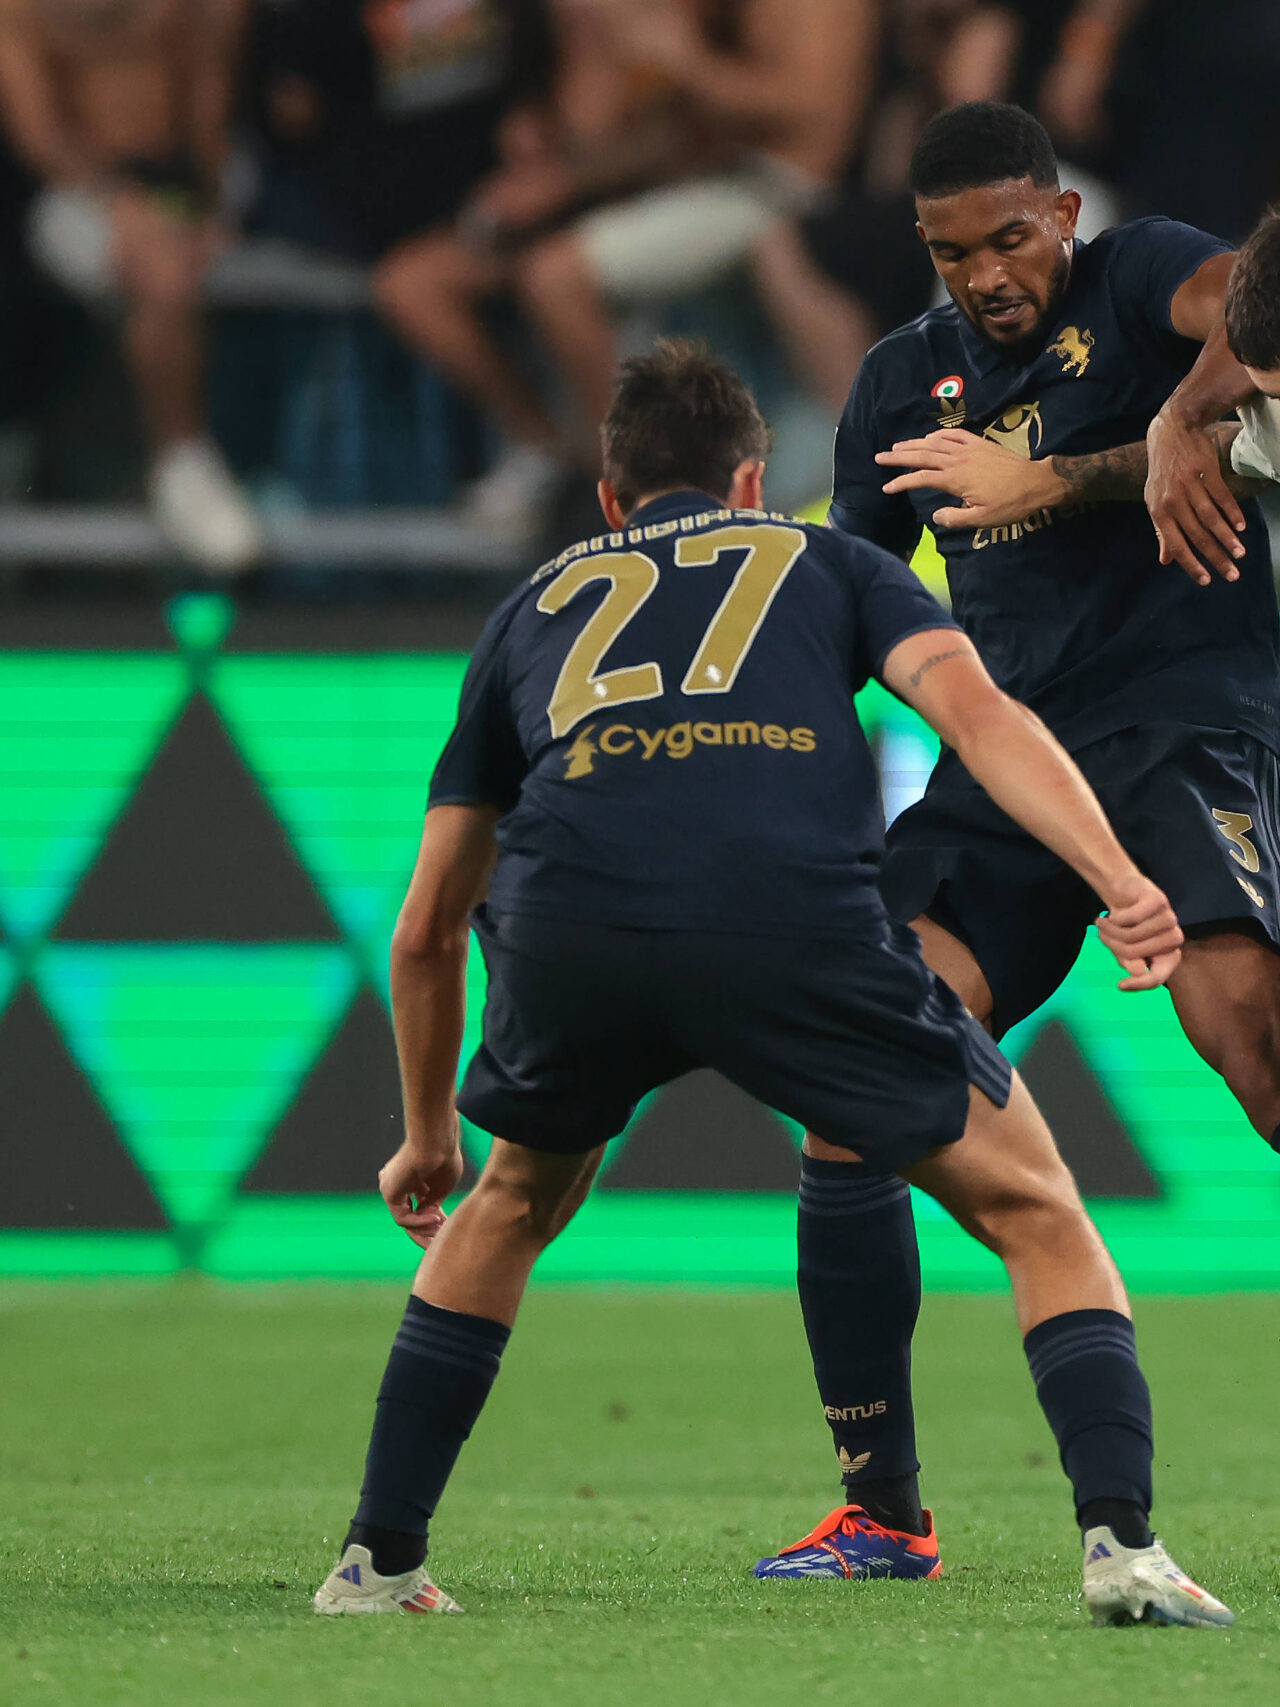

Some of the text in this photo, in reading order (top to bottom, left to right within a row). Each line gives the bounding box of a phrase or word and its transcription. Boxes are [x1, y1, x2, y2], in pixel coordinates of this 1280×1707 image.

[536, 524, 807, 739] 27
[599, 720, 818, 760] Cygames
[1211, 807, 1260, 873] 3
